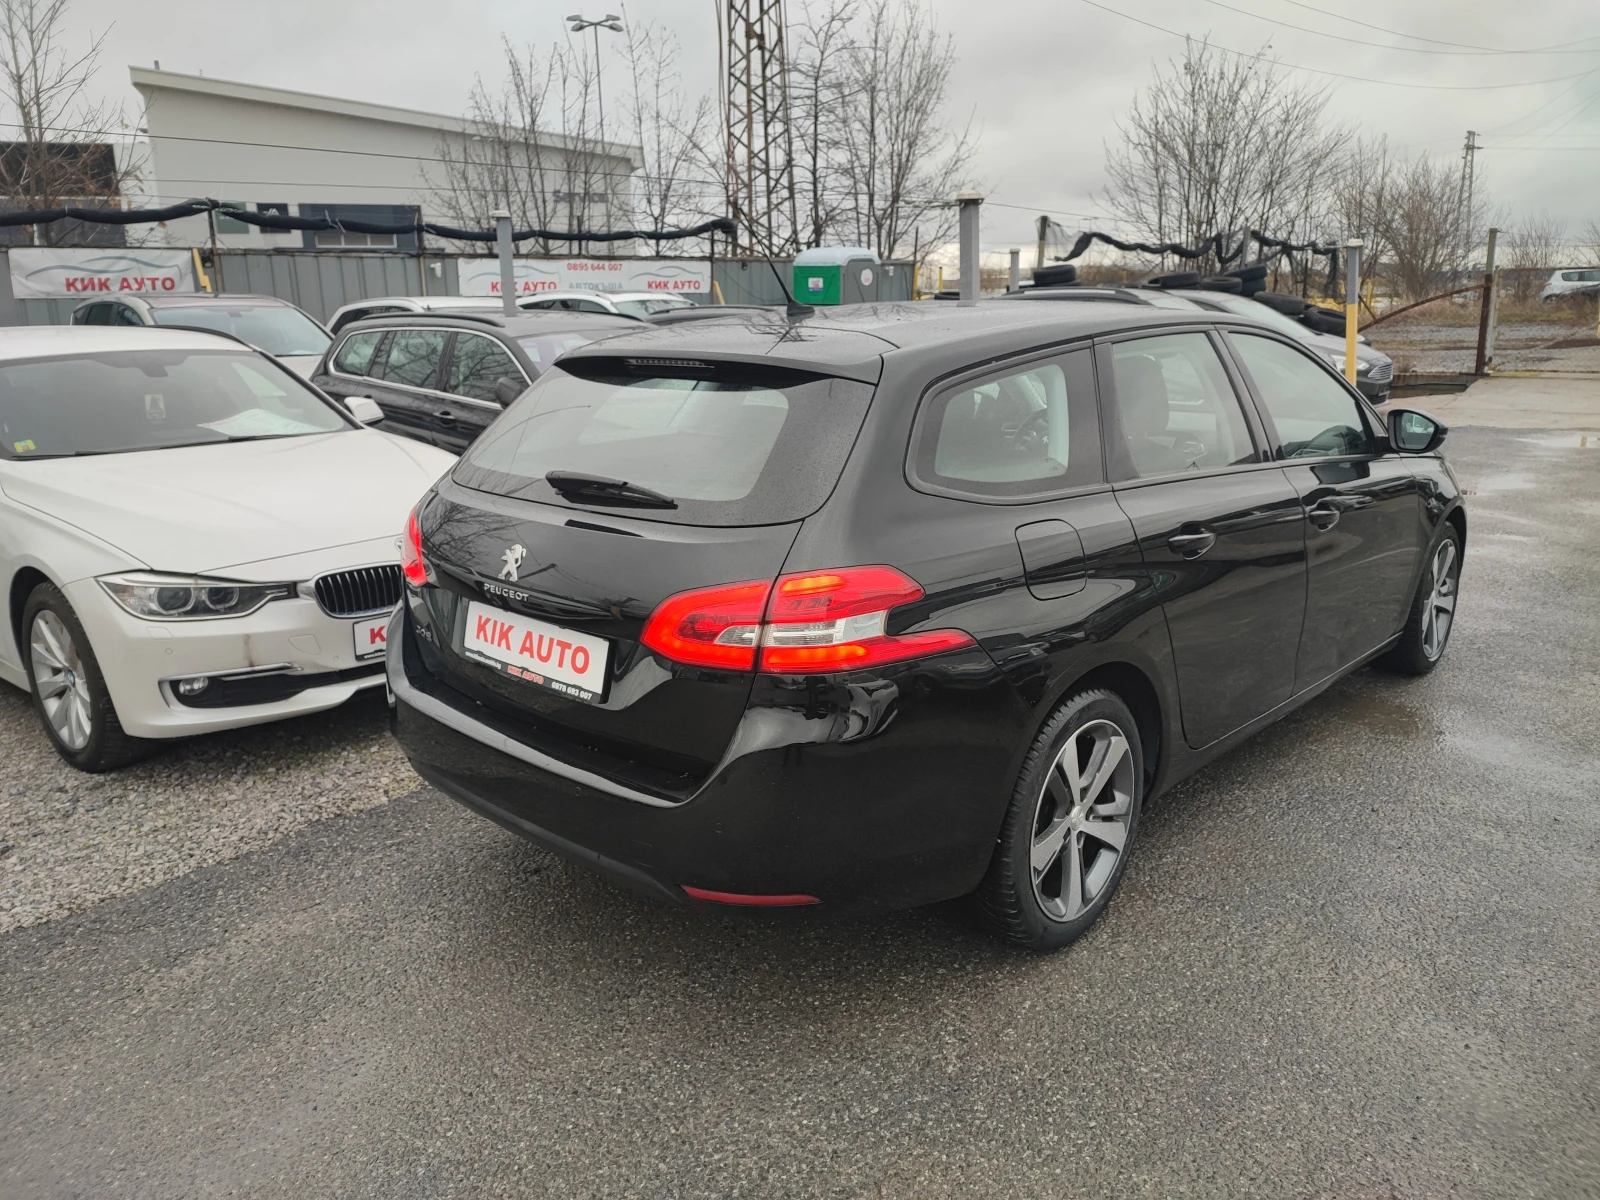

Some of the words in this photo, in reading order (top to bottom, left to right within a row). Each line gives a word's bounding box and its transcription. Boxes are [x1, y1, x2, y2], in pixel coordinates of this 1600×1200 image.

[566, 262, 589, 271] 0895
[590, 263, 605, 271] 644
[608, 263, 623, 271] 007
[65, 277, 111, 292] КИК
[118, 277, 176, 291] АУТО
[523, 281, 557, 292] АУТО
[647, 280, 669, 290] КИК
[673, 280, 701, 290] АУТО
[484, 583, 529, 601] PEUGEOT
[475, 614, 515, 652] KIK
[518, 630, 591, 675] AUTO
[507, 665, 522, 678] KIK
[522, 671, 545, 685] AUTO
